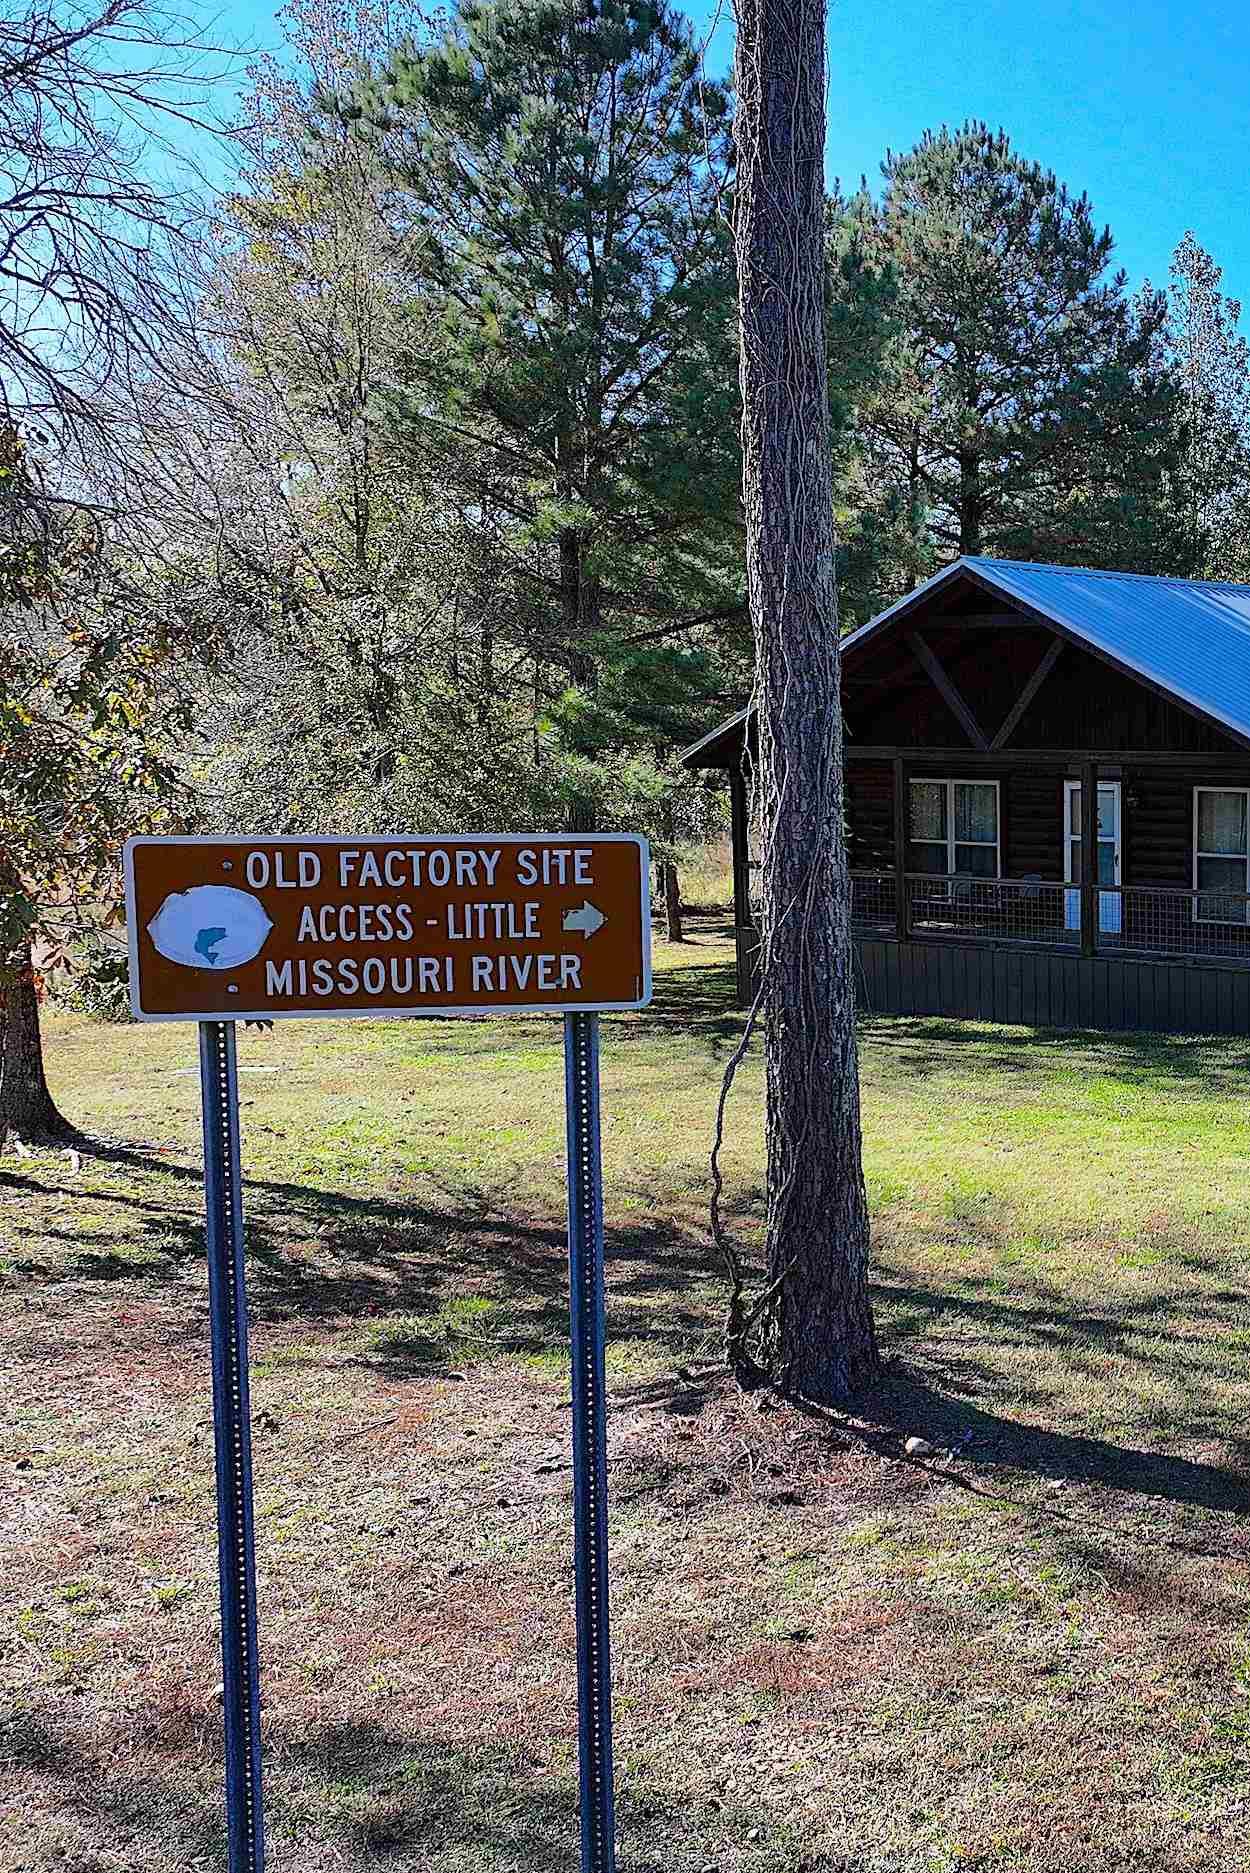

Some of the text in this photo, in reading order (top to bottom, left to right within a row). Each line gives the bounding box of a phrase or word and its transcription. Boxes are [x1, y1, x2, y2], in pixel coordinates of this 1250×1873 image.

[246, 849, 594, 888] OLD FACTORY SITE
[298, 904, 413, 942] ACCESS
[447, 902, 541, 939] LITTLE
[265, 954, 582, 996] MISSOURI RIVER
